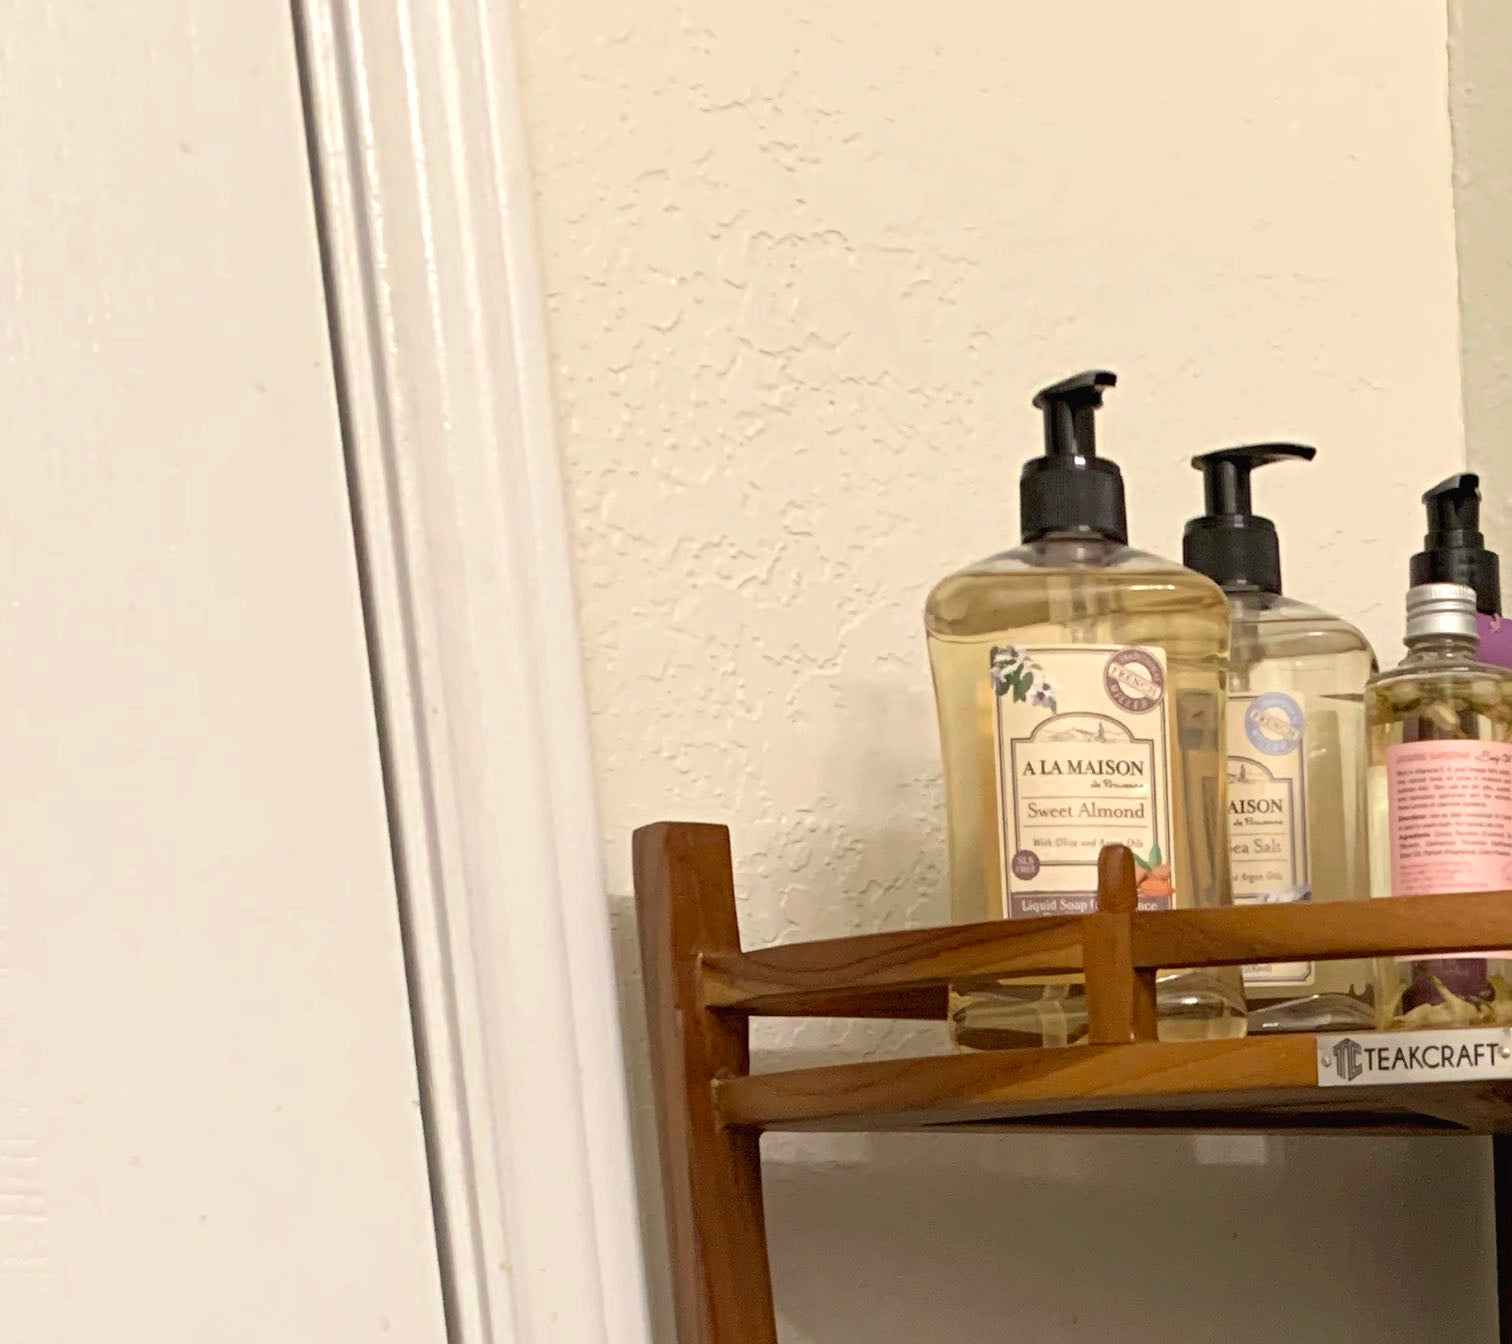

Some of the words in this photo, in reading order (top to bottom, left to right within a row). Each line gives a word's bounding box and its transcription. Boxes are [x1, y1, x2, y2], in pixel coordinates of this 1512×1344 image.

[1022, 760, 1035, 776] A
[1040, 760, 1062, 776] LA
[1067, 760, 1145, 777] MAISON
[1027, 802, 1073, 820] Sweet
[1078, 801, 1146, 820] Almond
[1228, 799, 1283, 815] AISON
[1021, 899, 1057, 913] Liquid
[1059, 898, 1087, 913] Soap
[1363, 1043, 1499, 1071] TEAKCRAFT
